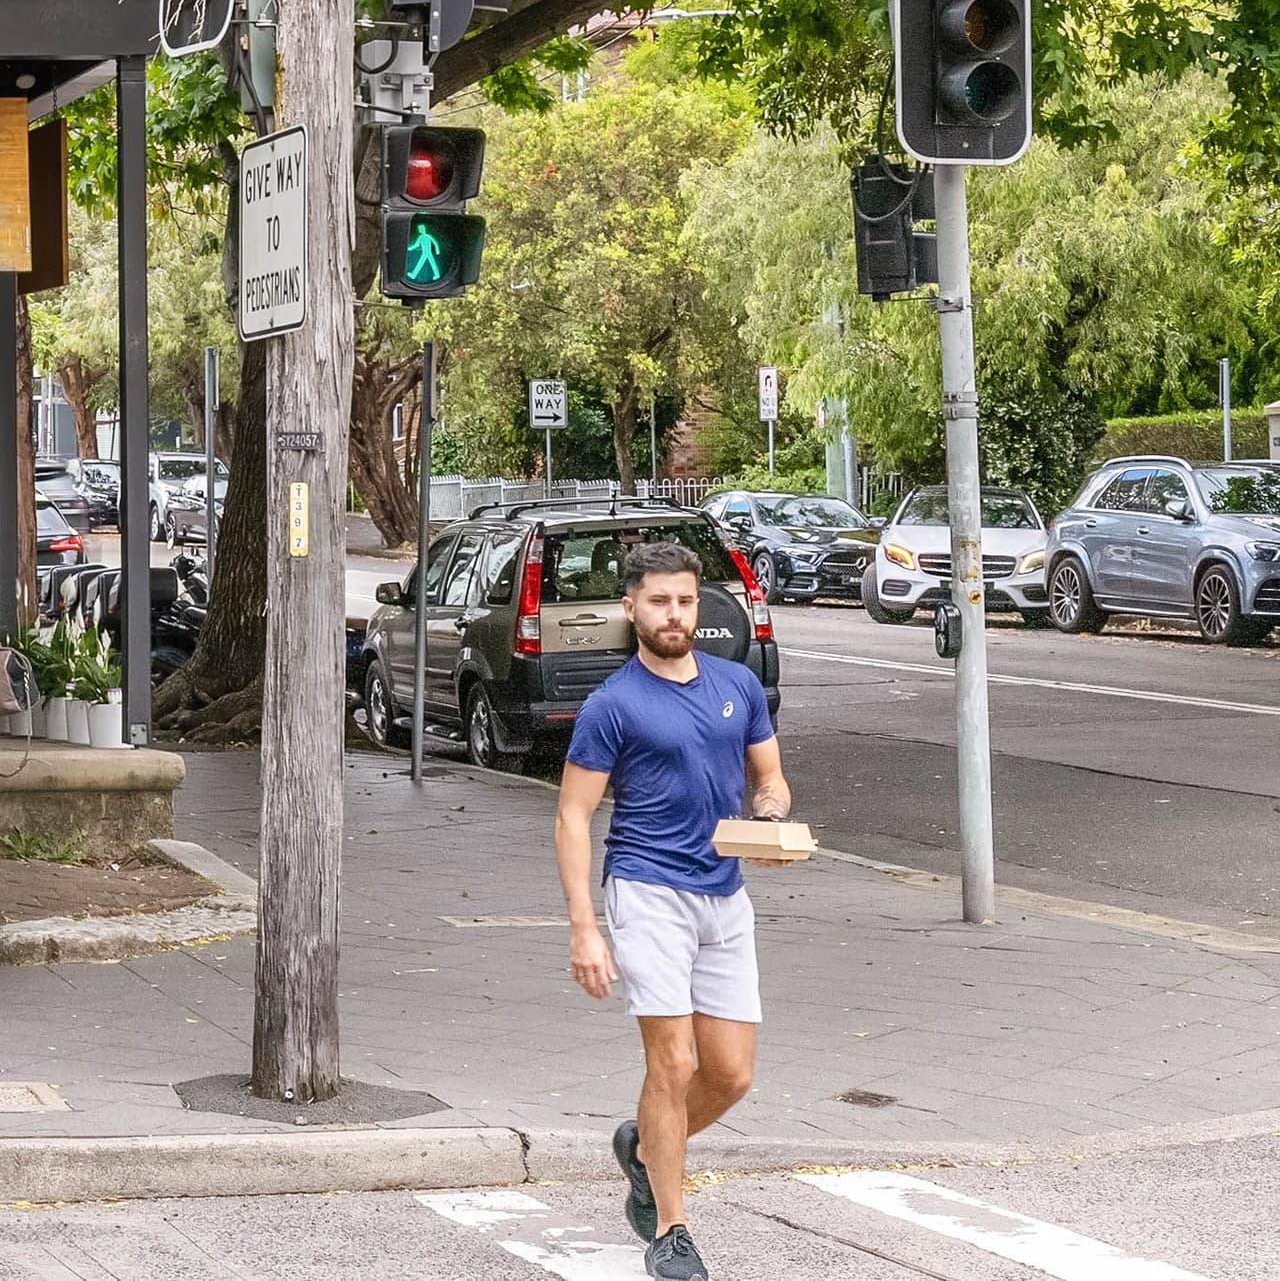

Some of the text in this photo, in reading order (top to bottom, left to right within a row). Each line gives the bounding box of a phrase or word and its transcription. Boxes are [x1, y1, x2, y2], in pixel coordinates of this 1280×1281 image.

[245, 151, 303, 204] GIVE WAY
[266, 214, 281, 253] TO
[246, 265, 301, 314] PEDESTRIANS
[536, 384, 561, 395] ONE
[535, 399, 562, 409] WAY
[693, 627, 734, 639] NDA
